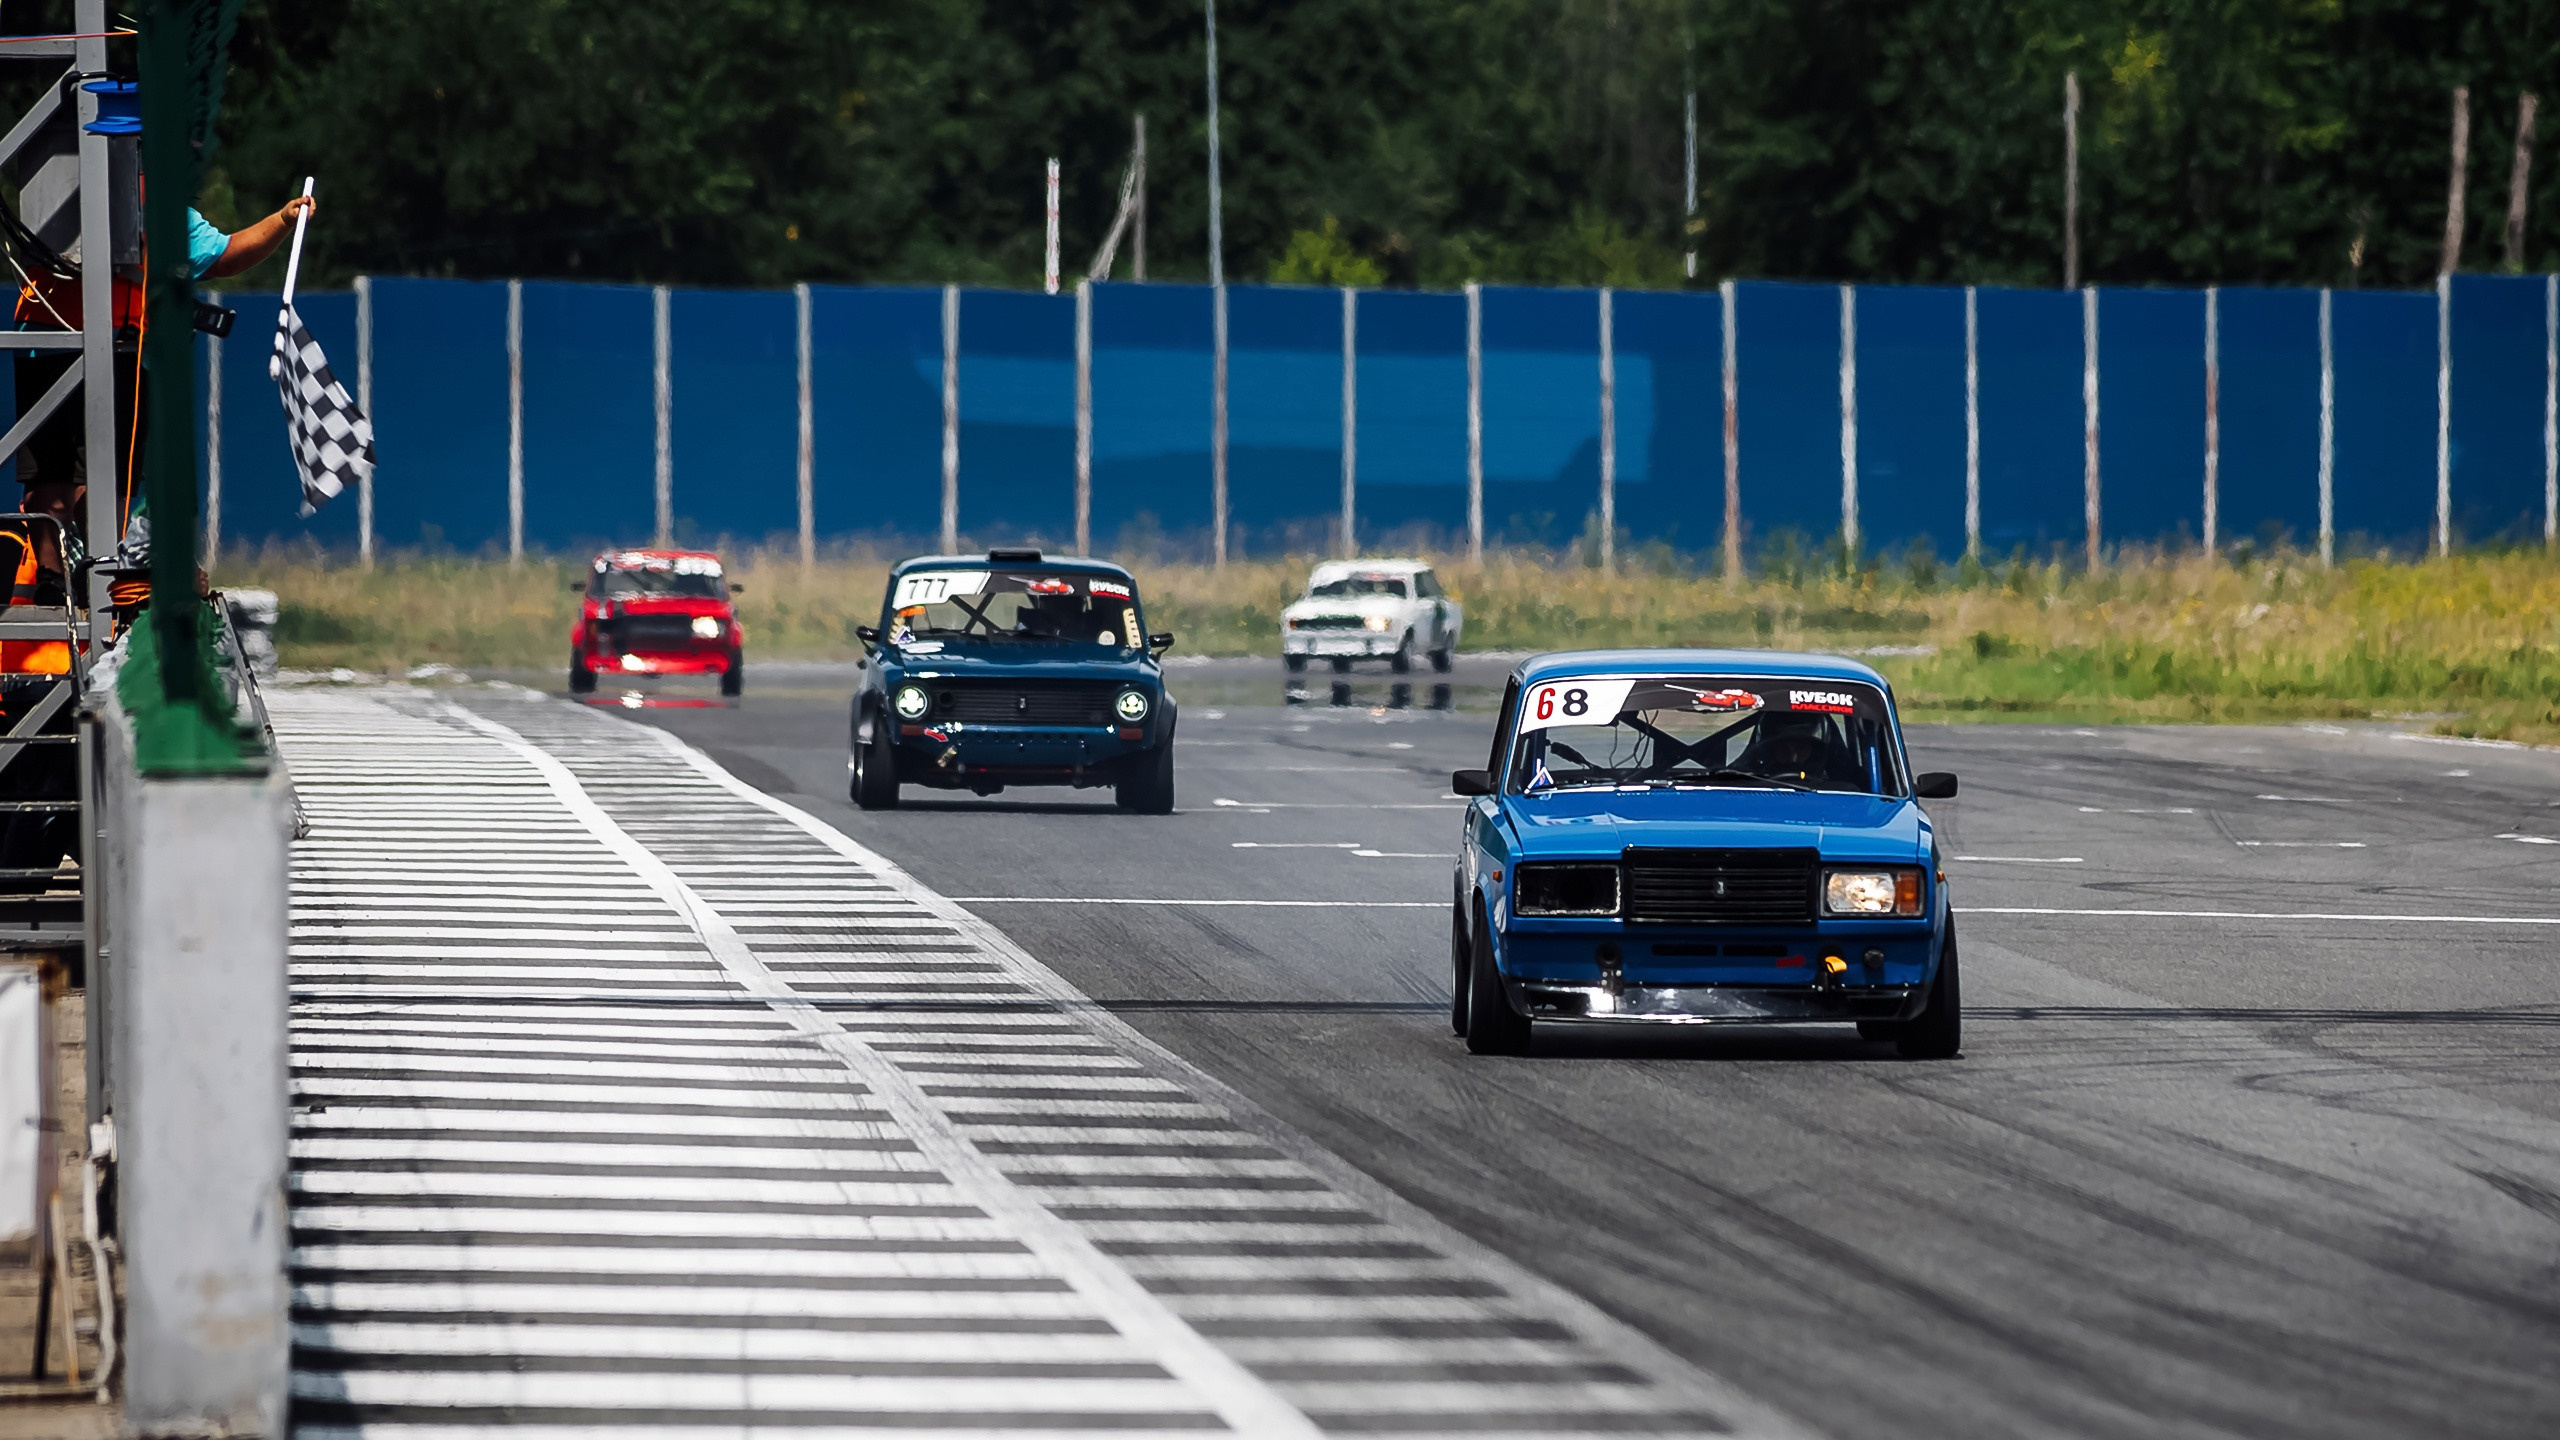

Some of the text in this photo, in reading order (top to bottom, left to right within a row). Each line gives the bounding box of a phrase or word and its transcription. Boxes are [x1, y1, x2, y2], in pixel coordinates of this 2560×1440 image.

[908, 578, 951, 600] 777
[1537, 687, 1589, 721] 68
[1789, 690, 1854, 707] КУБОК
